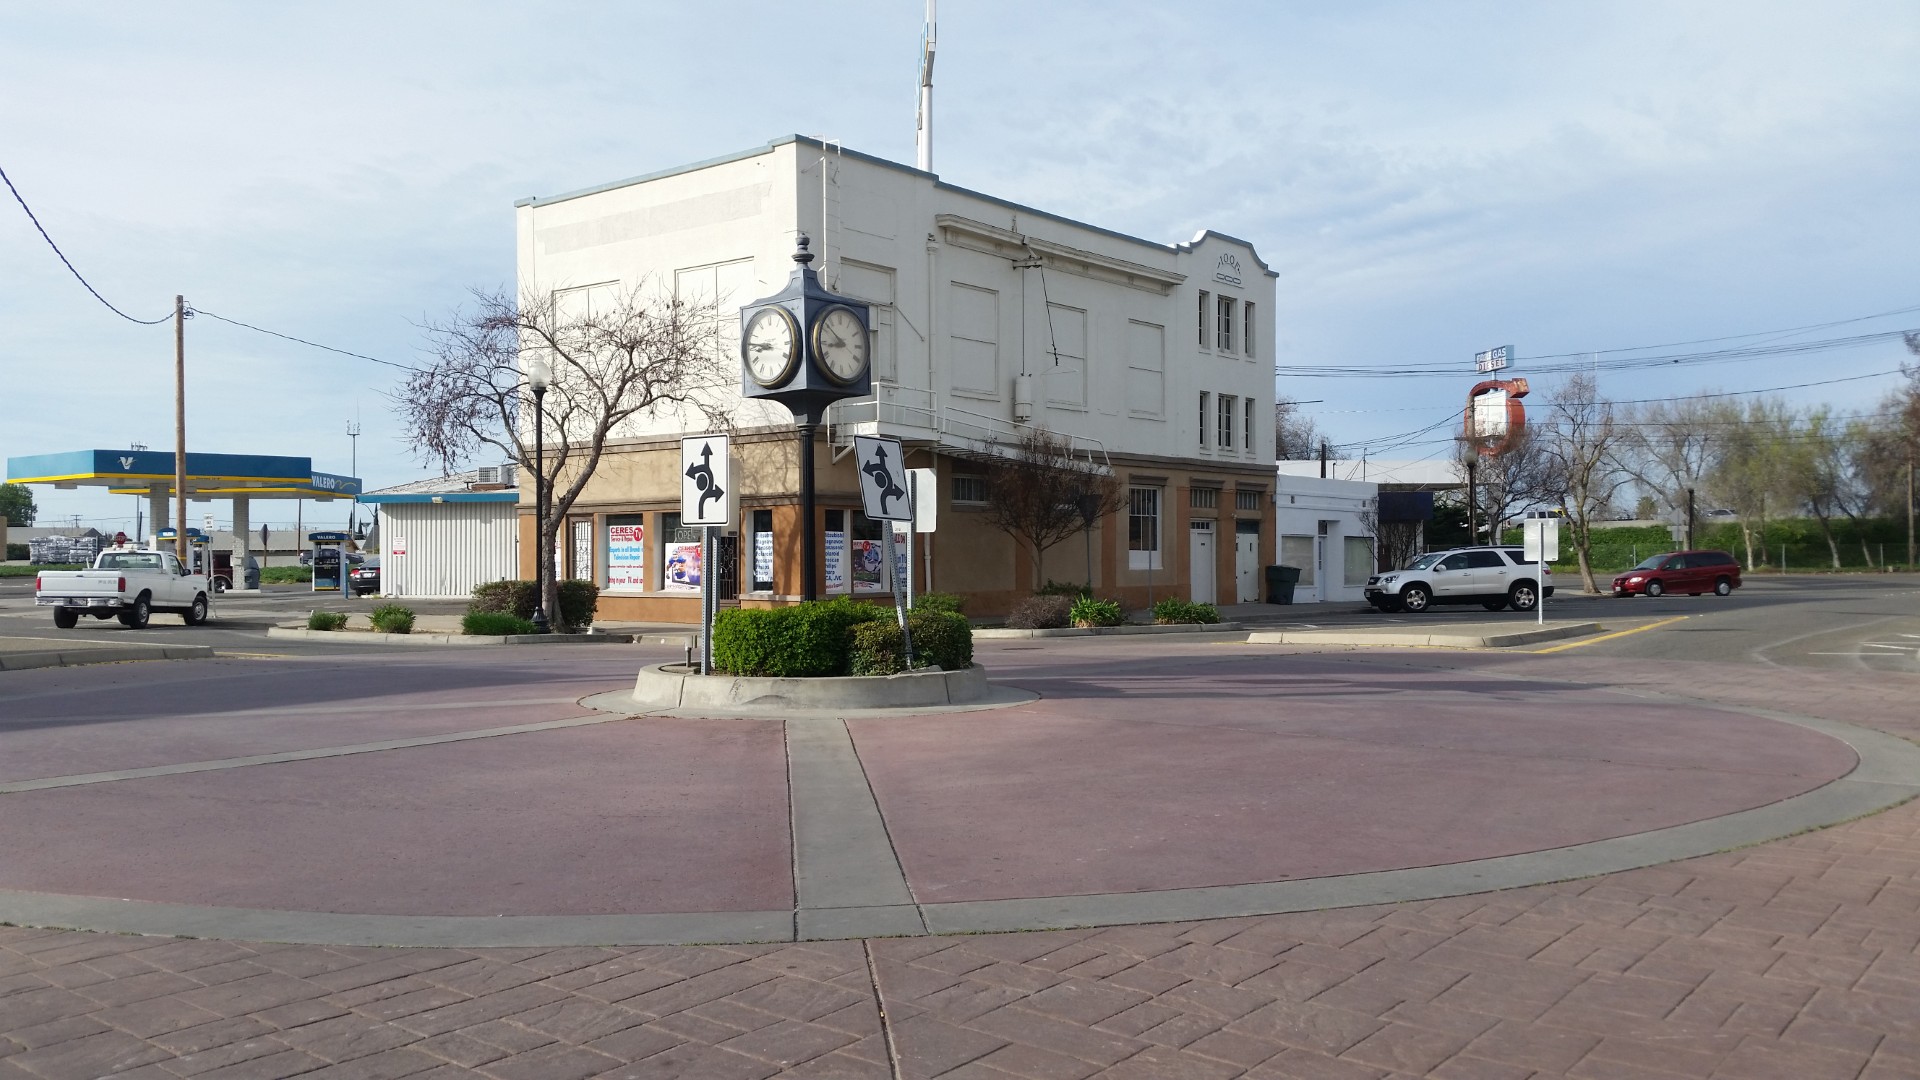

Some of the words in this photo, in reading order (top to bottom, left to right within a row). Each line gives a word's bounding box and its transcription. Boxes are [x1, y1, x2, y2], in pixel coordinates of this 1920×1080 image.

[1492, 348, 1506, 359] GAS
[1479, 359, 1504, 370] DIESEL
[312, 476, 335, 489] VALERO
